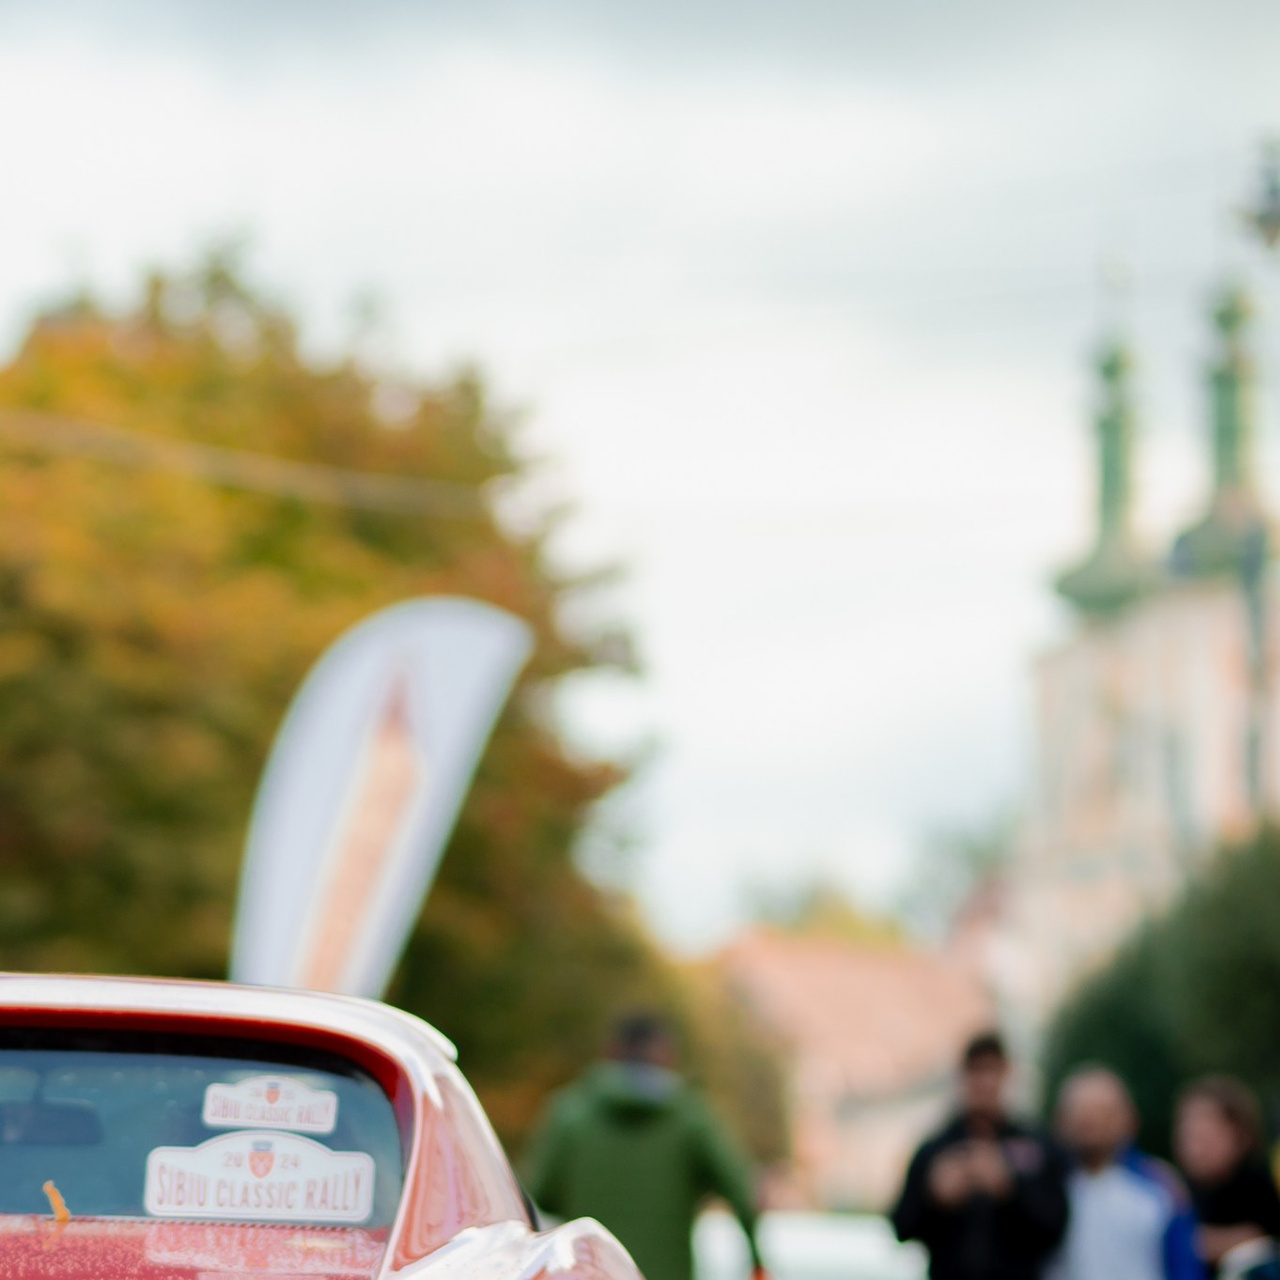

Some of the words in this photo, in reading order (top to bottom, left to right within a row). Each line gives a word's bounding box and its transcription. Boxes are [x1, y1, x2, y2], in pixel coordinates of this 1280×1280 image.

[223, 1152, 244, 1168] 20
[280, 1153, 300, 1169] 24
[156, 1163, 208, 1206] SIBIU
[217, 1177, 296, 1209] CLASSIC
[304, 1168, 363, 1211] RALLY
